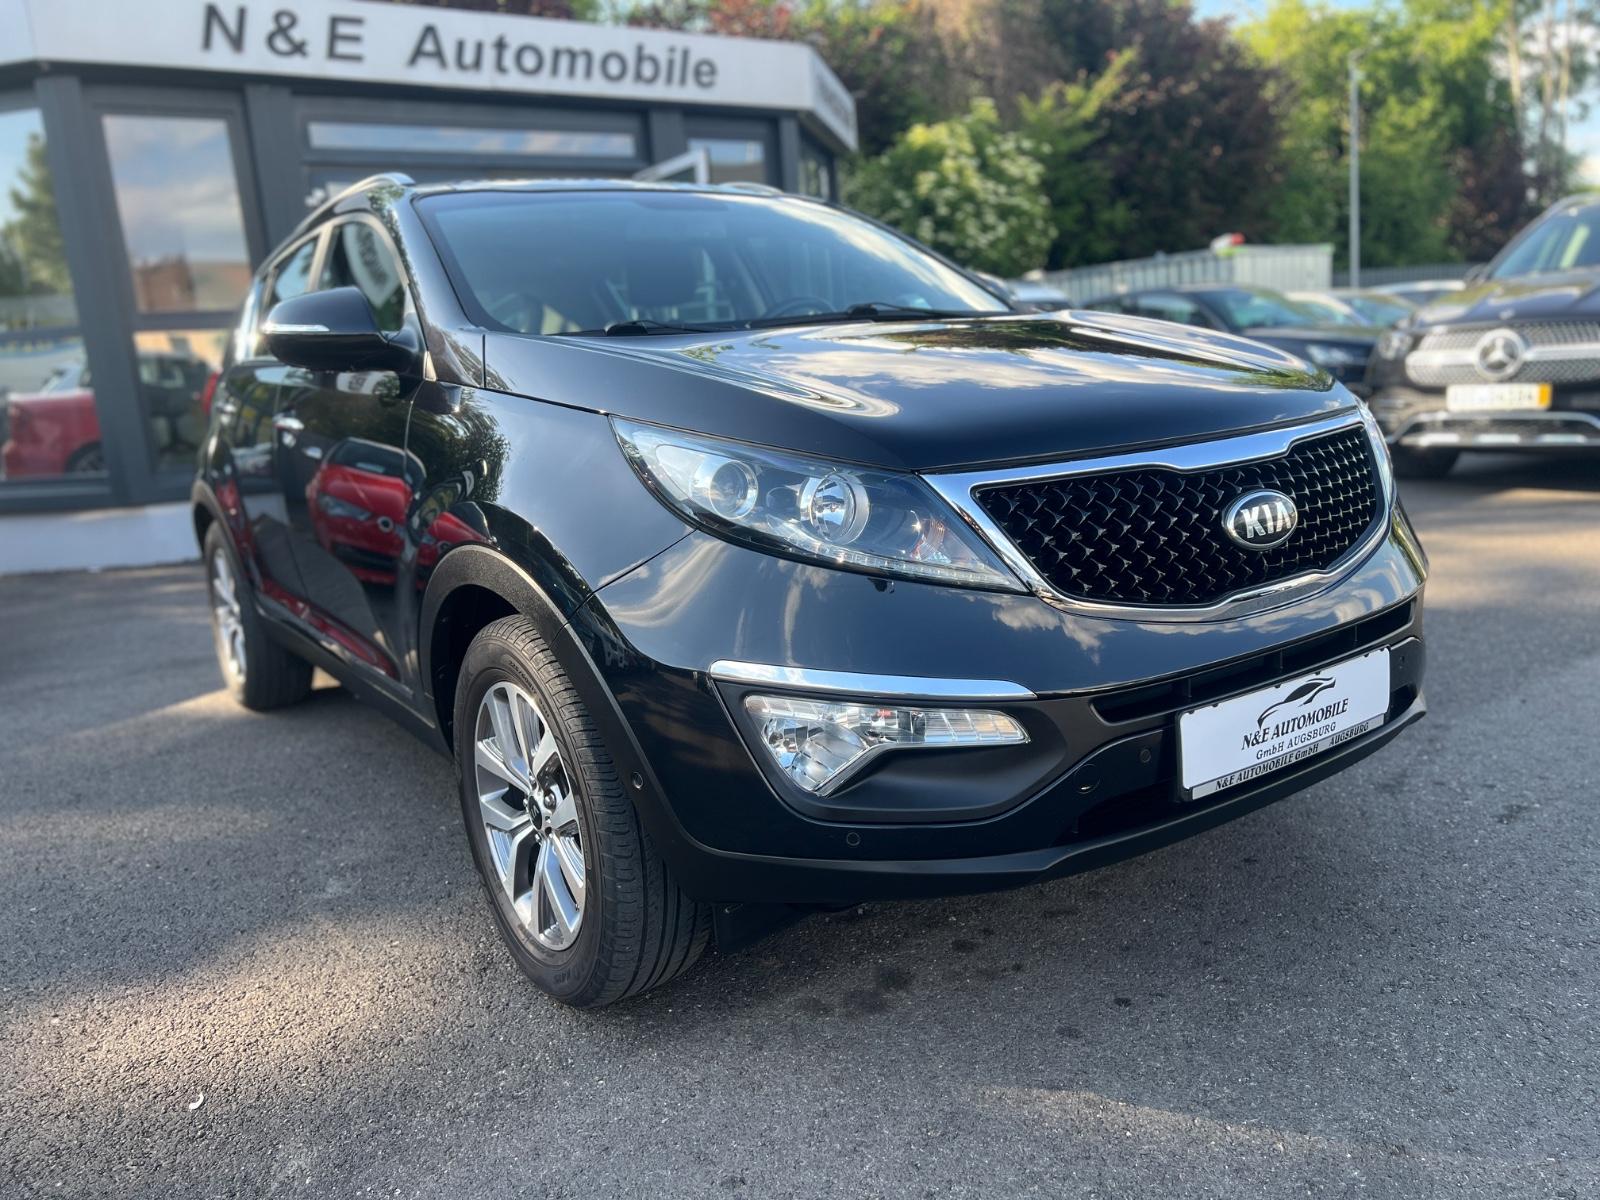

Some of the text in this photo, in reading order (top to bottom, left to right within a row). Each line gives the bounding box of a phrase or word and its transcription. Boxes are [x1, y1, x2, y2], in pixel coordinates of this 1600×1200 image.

[407, 23, 718, 90] Automobile
[1240, 500, 1292, 539] KIA
[1241, 698, 1349, 750] N&E AUTOMOBILE
[1256, 722, 1337, 760] GmbH AUGSBURG
[1215, 722, 1370, 791] N&E AUTOMOBILE GmbH AUGSBURG
